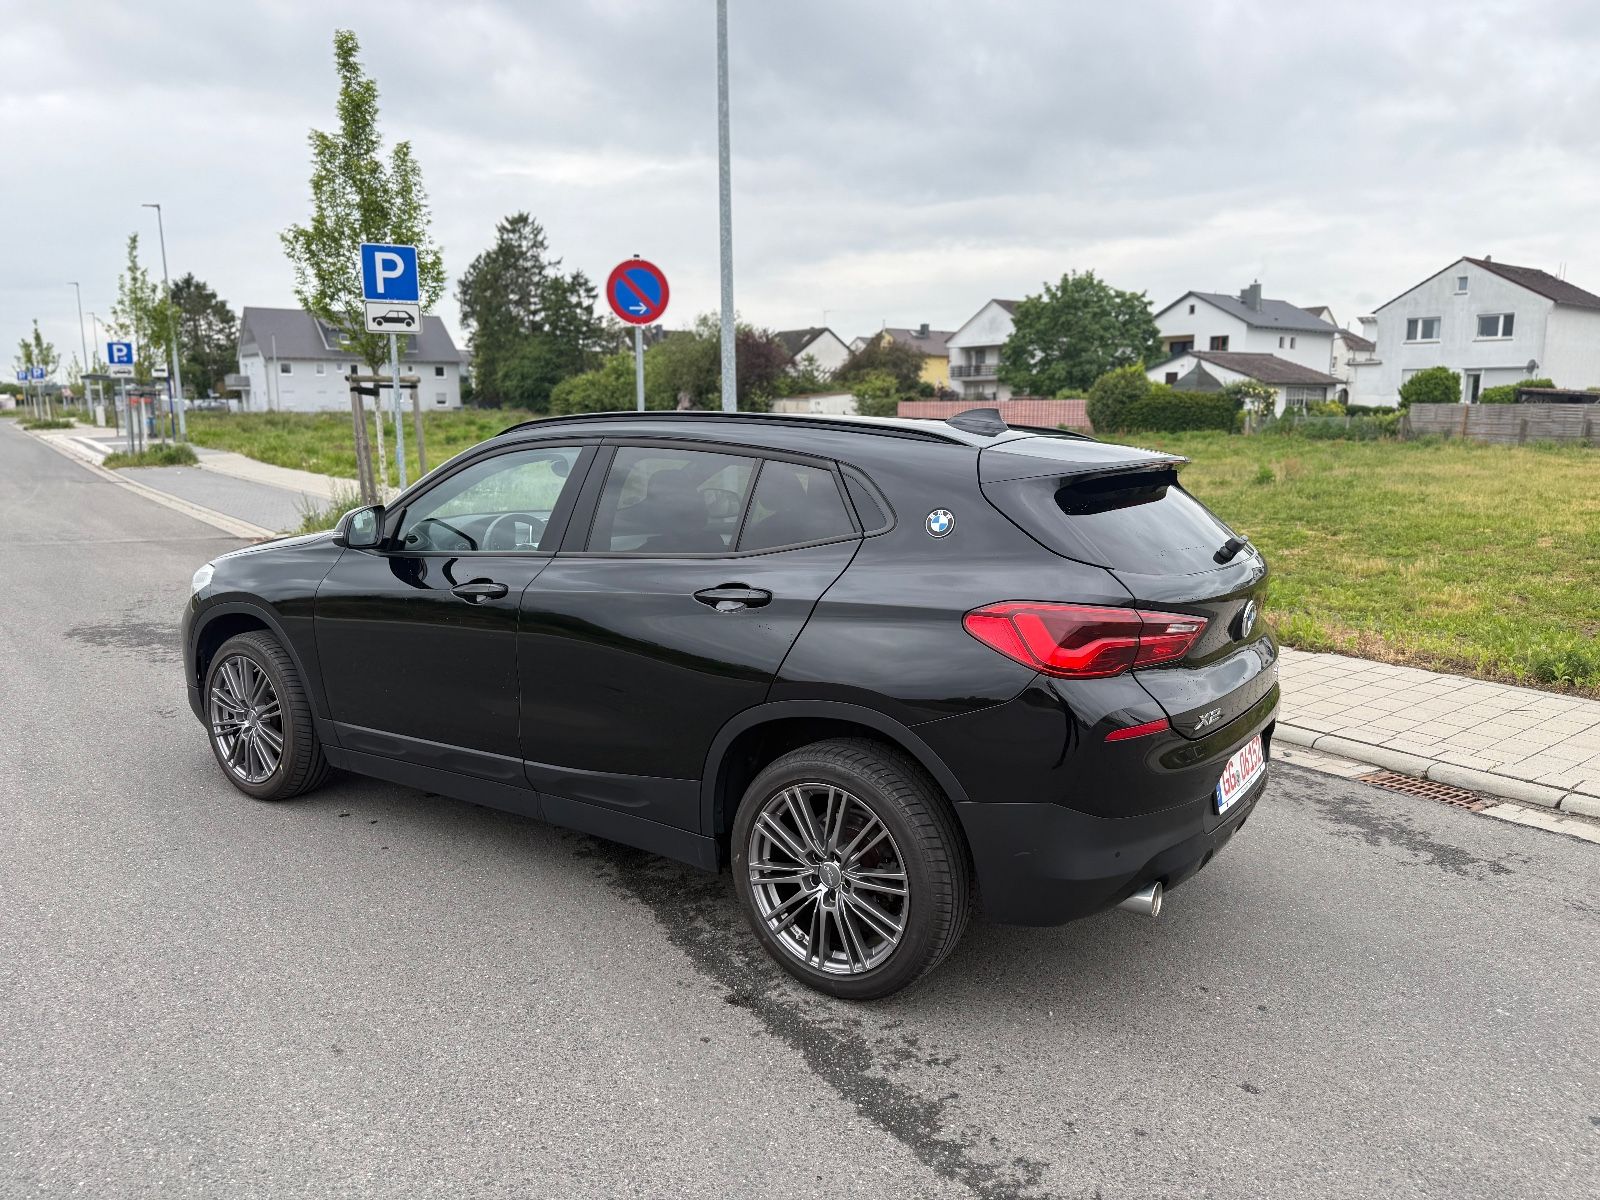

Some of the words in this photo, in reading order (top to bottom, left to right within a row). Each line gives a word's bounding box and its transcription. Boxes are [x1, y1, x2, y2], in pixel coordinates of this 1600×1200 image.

[374, 251, 405, 294] P
[112, 344, 128, 363] P
[1193, 707, 1221, 731] X2
[1222, 760, 1238, 797] GG
[1239, 735, 1262, 781] 06152
